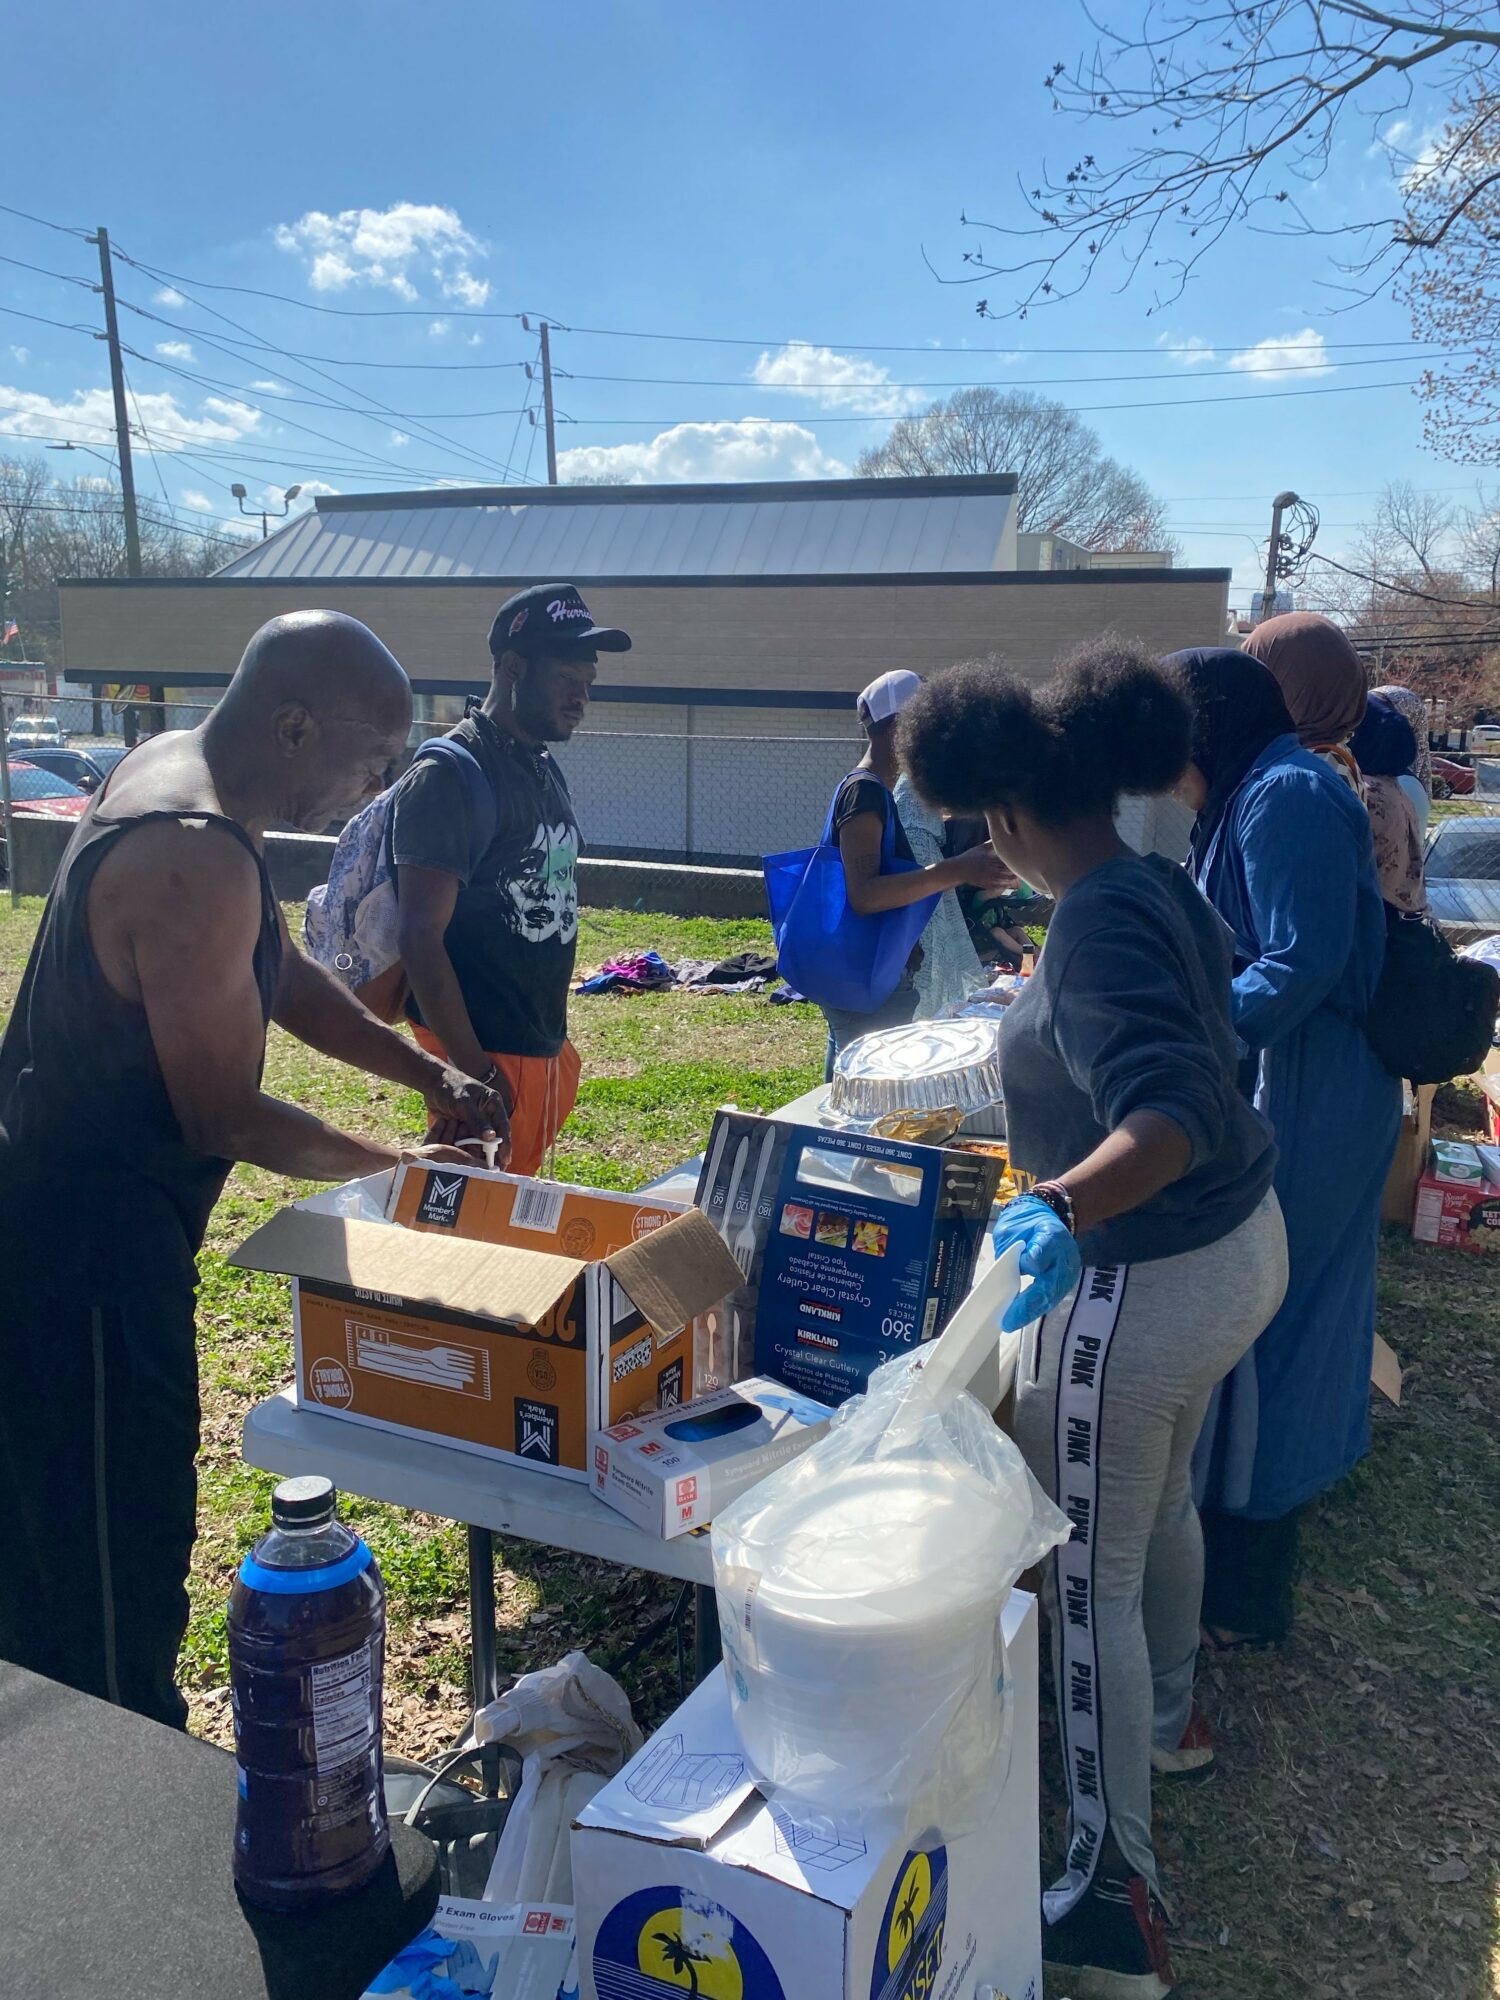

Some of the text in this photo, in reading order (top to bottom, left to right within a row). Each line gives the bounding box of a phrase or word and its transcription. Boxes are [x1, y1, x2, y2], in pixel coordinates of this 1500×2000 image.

[817, 1135, 836, 1145] PIEZAS
[866, 1144, 884, 1154] PIECES
[713, 1195, 724, 1205] 60
[736, 1200, 749, 1211] 120
[423, 1203, 455, 1216] Member's
[428, 1212, 446, 1222] Mark
[758, 1205, 772, 1216] 180
[635, 1214, 661, 1229] STRONG
[807, 1252, 847, 1269] Tipo Cristal
[933, 1240, 944, 1288] KIRKLAND
[788, 1256, 865, 1282] Transparente Acabado
[816, 1273, 826, 1281] de
[777, 1273, 810, 1291] Cutlery
[827, 1275, 862, 1291] Cubiertos
[1089, 1266, 1118, 1303] INK
[811, 1284, 836, 1298] Clear
[838, 1291, 871, 1307] Crystal
[799, 1303, 841, 1322] KIRKLAND
[896, 1301, 917, 1311] PIEZAS
[888, 1308, 915, 1321] PIECES
[797, 1328, 839, 1347] KIRKLAND
[881, 1317, 914, 1342] 360
[774, 1343, 803, 1359] Crystal
[805, 1352, 827, 1365] Clear
[829, 1359, 860, 1377] Cutlery
[1071, 1335, 1101, 1389] PINK
[314, 1368, 344, 1383] DURABLE
[534, 1368, 548, 1381] USA
[783, 1360, 813, 1375] Cubiertos
[815, 1369, 823, 1378] de
[704, 1374, 719, 1386] 120
[782, 1367, 851, 1394] Transparente Acabado
[323, 1383, 350, 1398] STRONG
[527, 1403, 546, 1416] Mark
[519, 1410, 555, 1427] Member's
[639, 1441, 661, 1455] M
[1067, 1416, 1092, 1467] PINK
[662, 1456, 680, 1466] 100
[762, 1445, 791, 1463] Nitrile
[682, 1505, 692, 1519] M
[1067, 1494, 1090, 1545] PINK
[1066, 1575, 1090, 1630] PINK
[313, 1659, 350, 1675] Nutrition
[351, 1647, 370, 1663] Facts
[1071, 1660, 1093, 1716] PINK
[314, 1690, 345, 1705] Calories
[1074, 1746, 1099, 1801] PINK
[1069, 1822, 1099, 1879] PINK
[445, 1906, 476, 1919] Exam
[479, 1911, 515, 1922] Gloves
